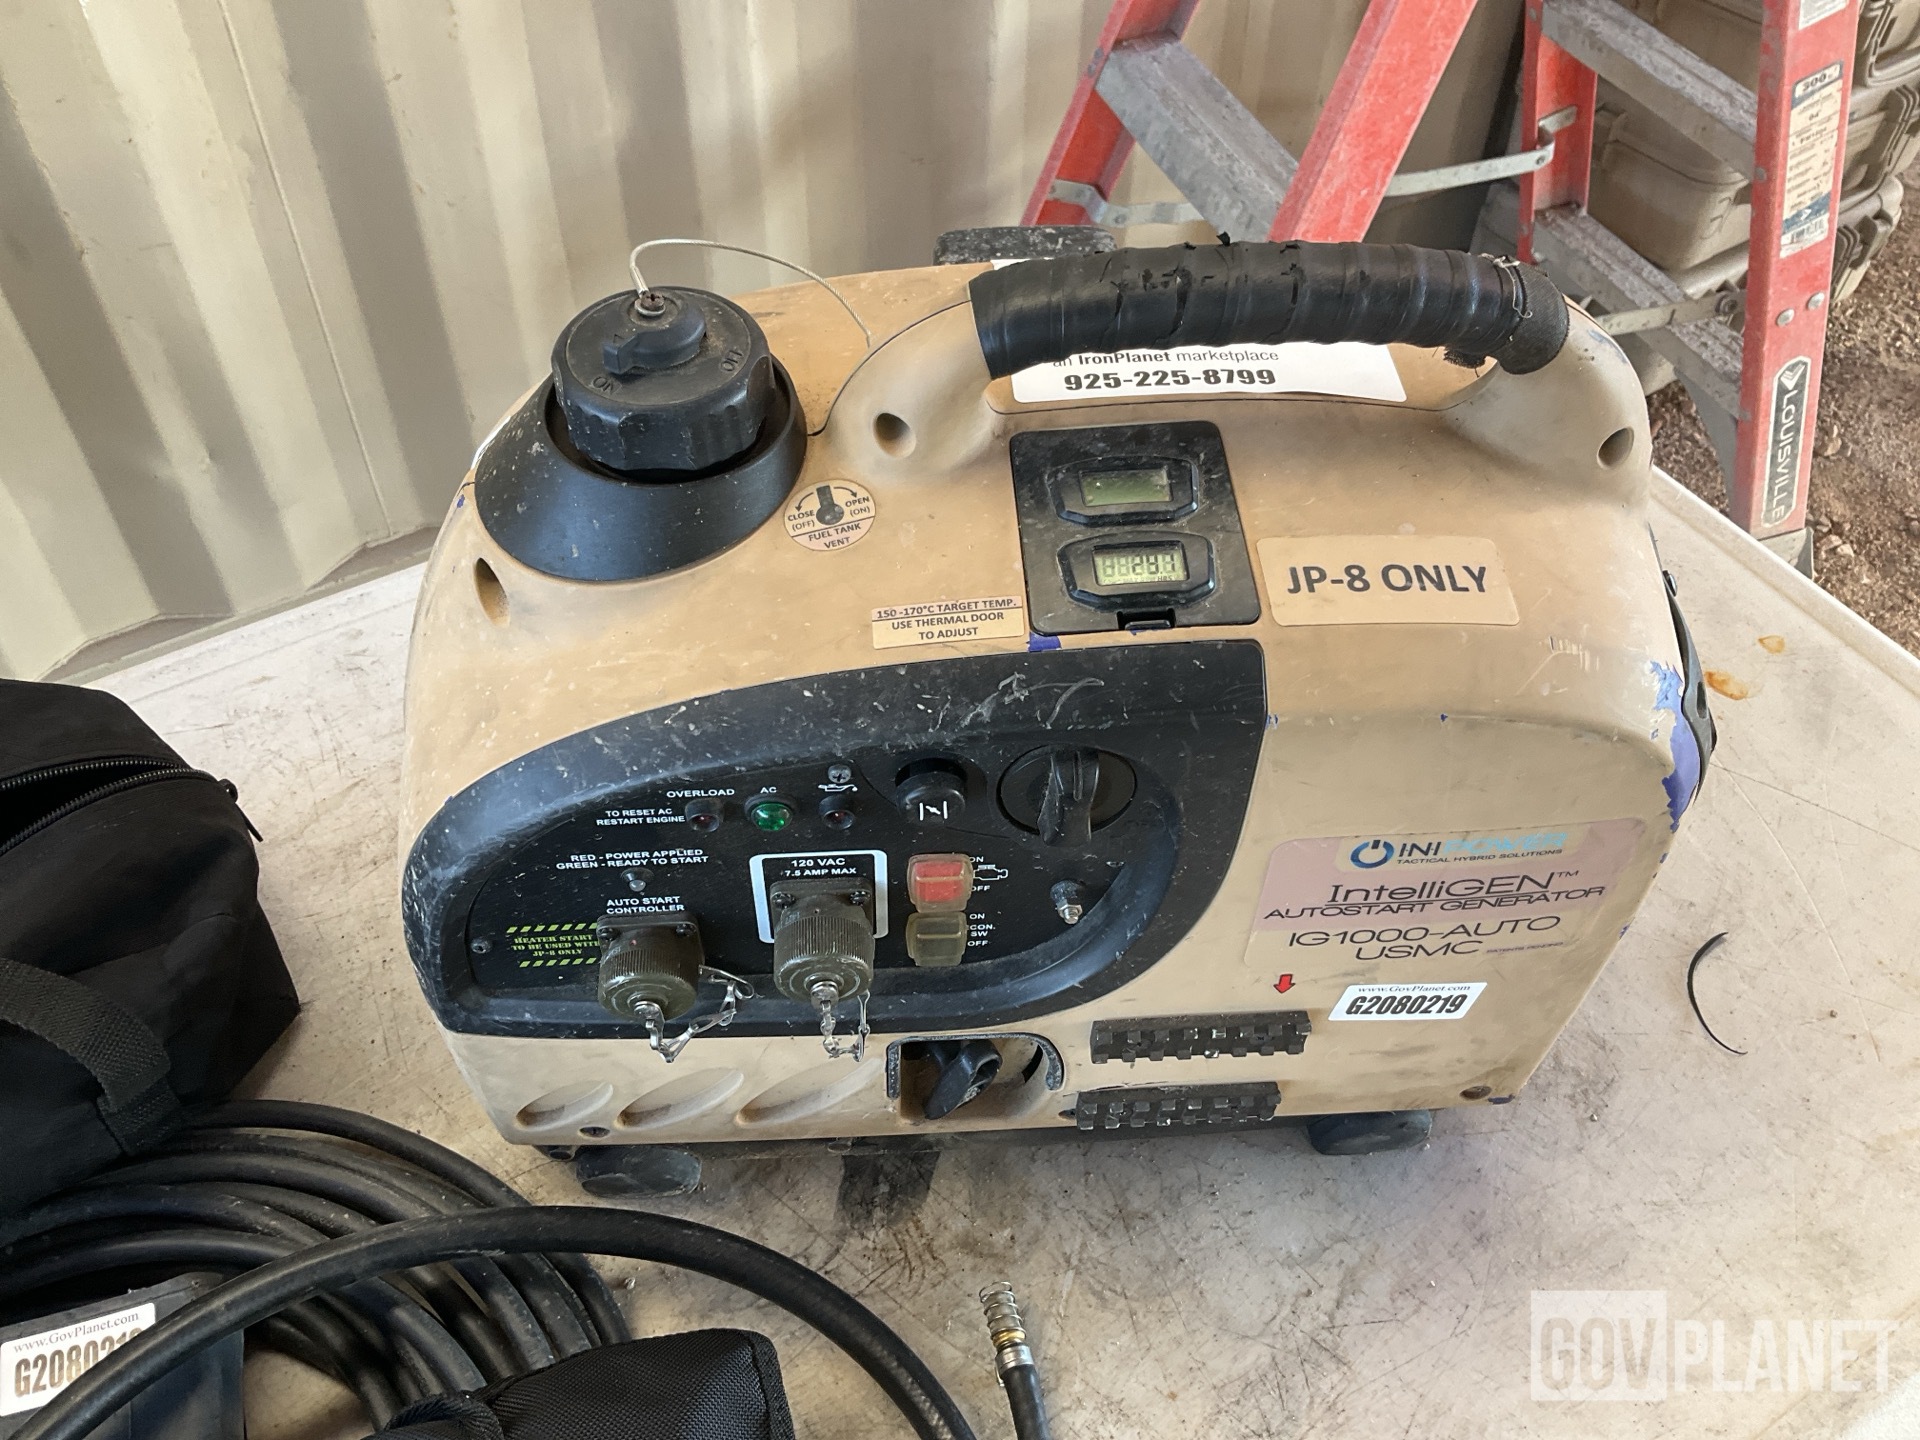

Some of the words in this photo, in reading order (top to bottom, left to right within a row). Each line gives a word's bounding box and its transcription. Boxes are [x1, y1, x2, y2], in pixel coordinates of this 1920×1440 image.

[1078, 351, 1172, 366] IronPlanet
[1176, 349, 1280, 363] marketplace
[1064, 368, 1277, 391] 925-225-8799
[1772, 389, 1799, 519] LOUISVILLE
[845, 495, 870, 508] OPEN
[787, 509, 815, 522] CLOSE
[849, 505, 871, 518] (ON)
[791, 519, 815, 532] (OFF)
[808, 531, 832, 542] FUEL
[834, 522, 862, 535] TANK
[823, 536, 851, 549] VENT
[1287, 564, 1371, 594] JP-8
[1381, 564, 1487, 593] ONLY
[877, 608, 897, 619] 150
[937, 600, 979, 612] TARGET
[982, 598, 1017, 608] TEMP.
[892, 619, 913, 630] USE
[915, 613, 969, 627] THERMAL
[971, 611, 1004, 622] DOOR
[918, 629, 935, 640] TO
[937, 626, 979, 638] ADJUST
[666, 788, 735, 799] OVERLOAD
[760, 786, 777, 794] AC
[605, 809, 620, 817] TO
[622, 808, 654, 816] RESET
[658, 807, 673, 816] AC
[596, 817, 644, 826] RESTART
[646, 815, 685, 824] ENGINE
[570, 854, 596, 862] RED
[605, 851, 650, 860] POWER
[652, 849, 703, 858] APPLIED
[791, 859, 814, 867] 120
[816, 857, 846, 866] VAC
[1397, 856, 1450, 865] TACTICAL
[1453, 853, 1496, 862] HYBRID
[1499, 848, 1563, 859] SOLUTIONS
[556, 861, 598, 870] GREEN
[607, 859, 648, 867] READY
[651, 857, 668, 865] TO
[670, 855, 709, 864] START
[831, 867, 857, 875] MAX
[606, 898, 640, 907] AUTO
[642, 895, 681, 904] START
[1264, 901, 1428, 920] AUTOSTART
[1440, 885, 1606, 912] GENERATOR
[606, 904, 685, 915] CONTROLLER
[1288, 915, 1561, 948] IG1000-AUTO
[513, 936, 557, 944] HEATER
[559, 934, 594, 942] START
[528, 943, 543, 951] BE
[545, 942, 572, 950] USED
[1355, 940, 1483, 961] USMC
[1358, 983, 1471, 993] www.GovPlanet.com
[1345, 994, 1468, 1015] G2080219
[13, 1311, 139, 1354] www.GovPlanet.com
